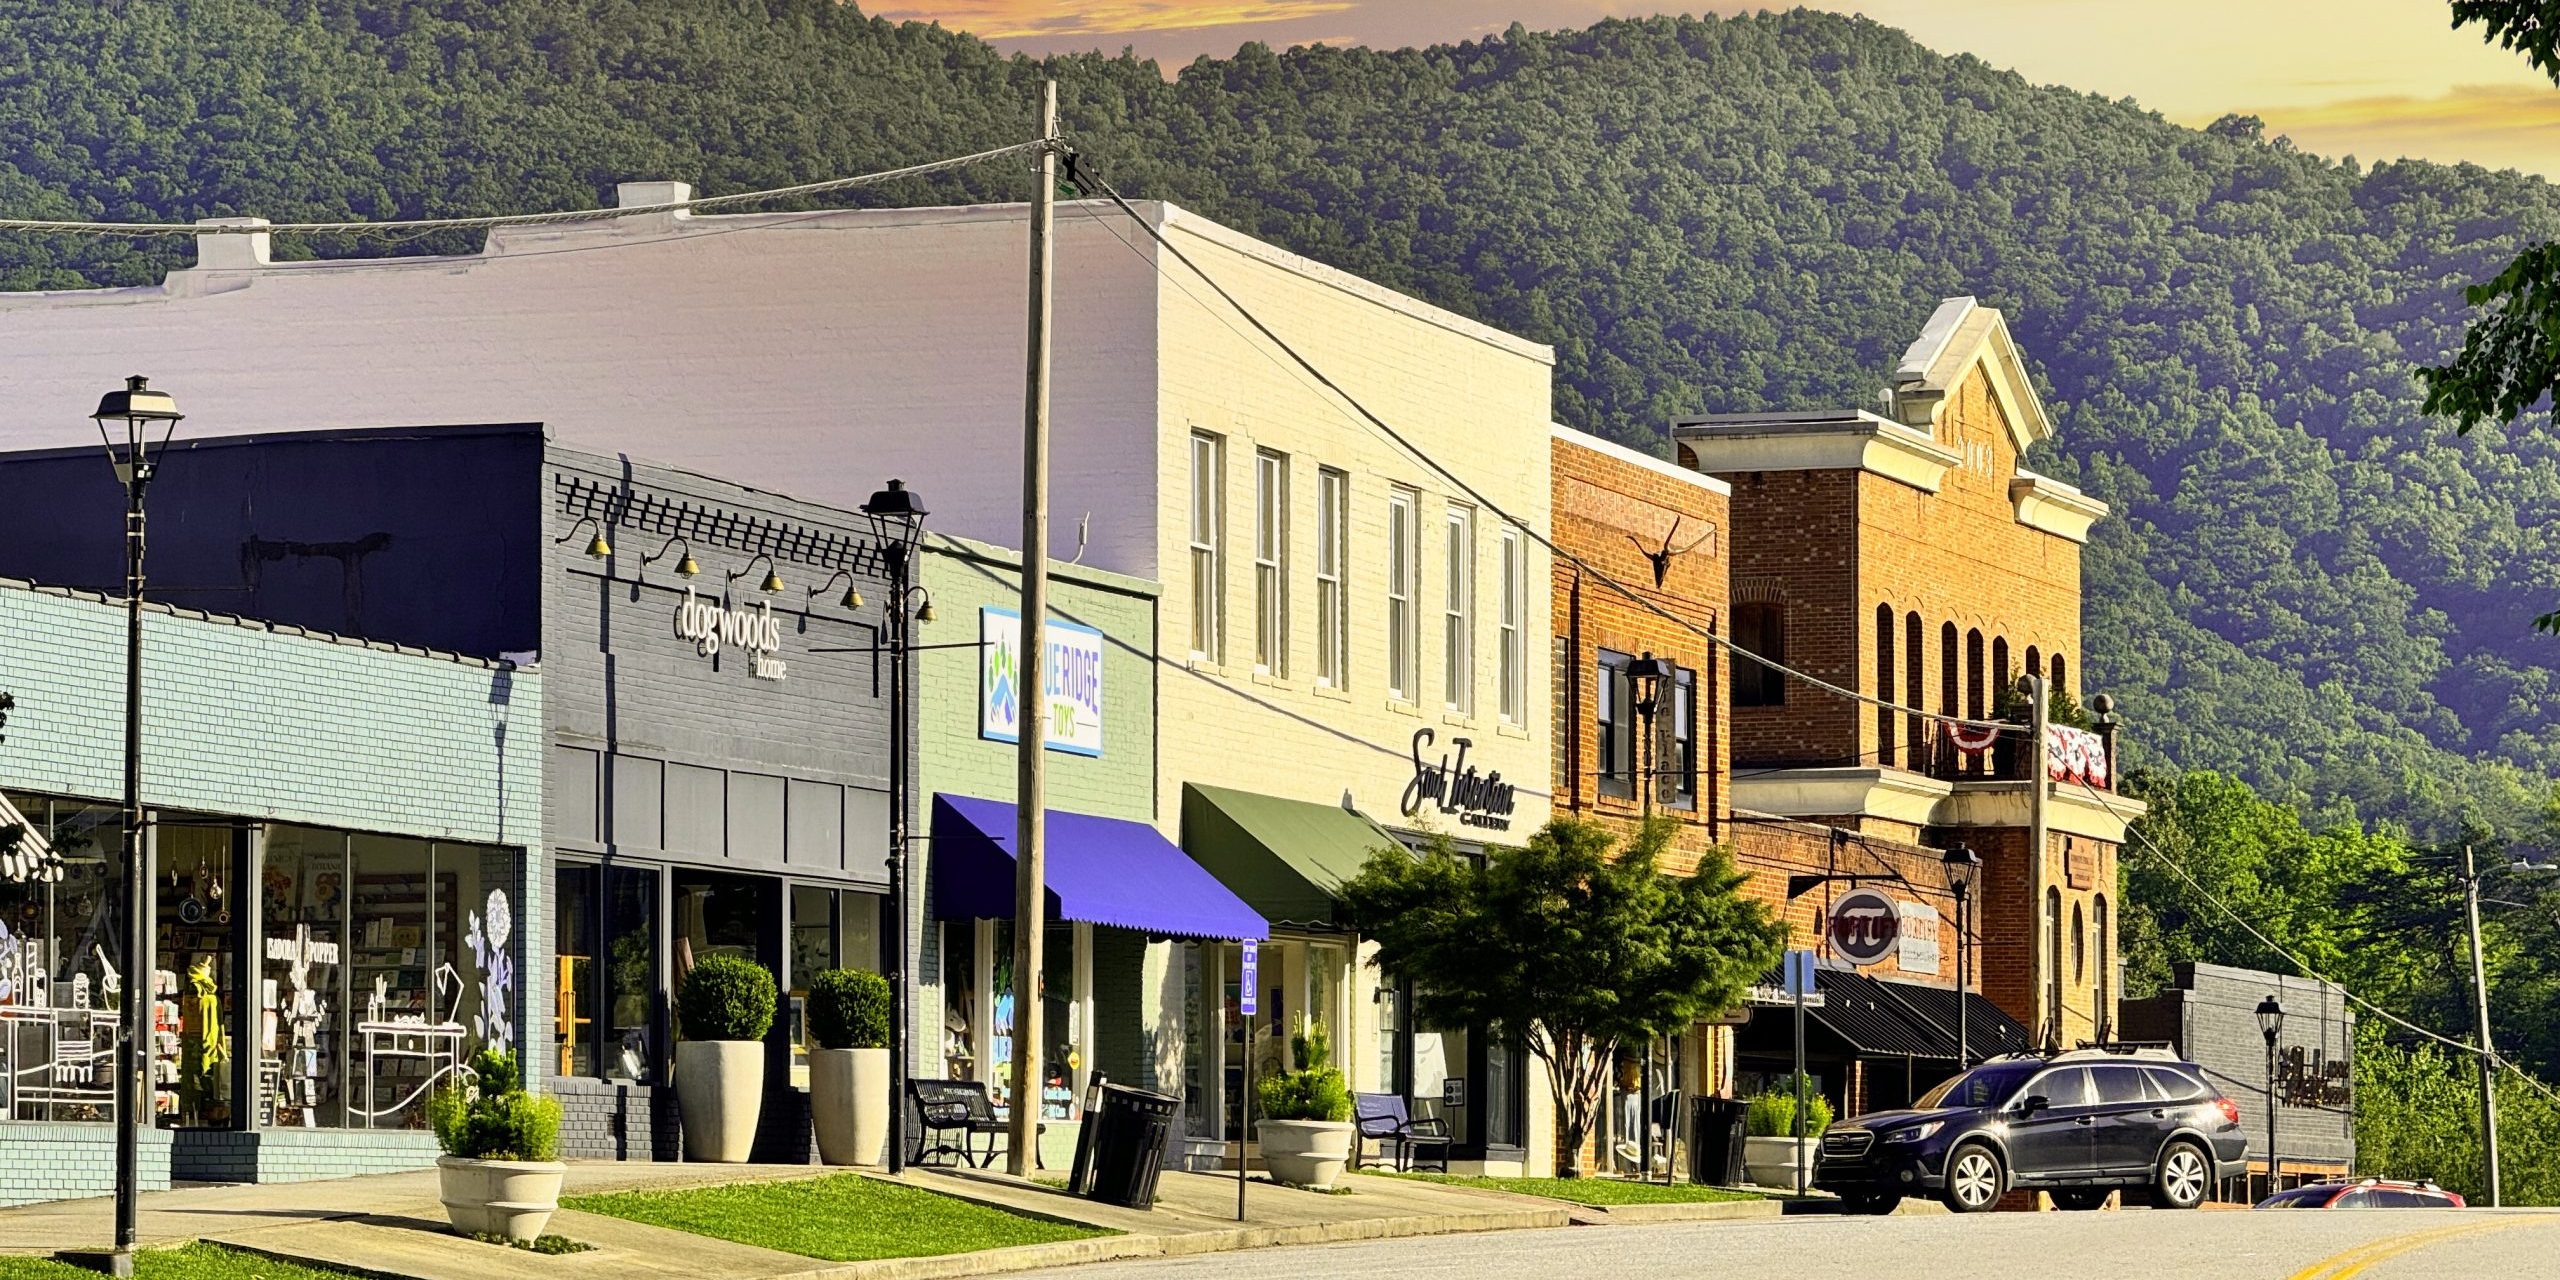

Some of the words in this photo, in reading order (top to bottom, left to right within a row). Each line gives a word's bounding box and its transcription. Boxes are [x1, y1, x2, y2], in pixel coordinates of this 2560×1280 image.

[682, 585, 780, 655] dogwoods
[756, 648, 787, 680] home
[1044, 641, 1060, 697] UE
[1062, 645, 1098, 716] RIDGE
[1053, 703, 1075, 738] TOYS
[266, 937, 297, 961] ISADORA
[309, 941, 339, 964] POPPER
